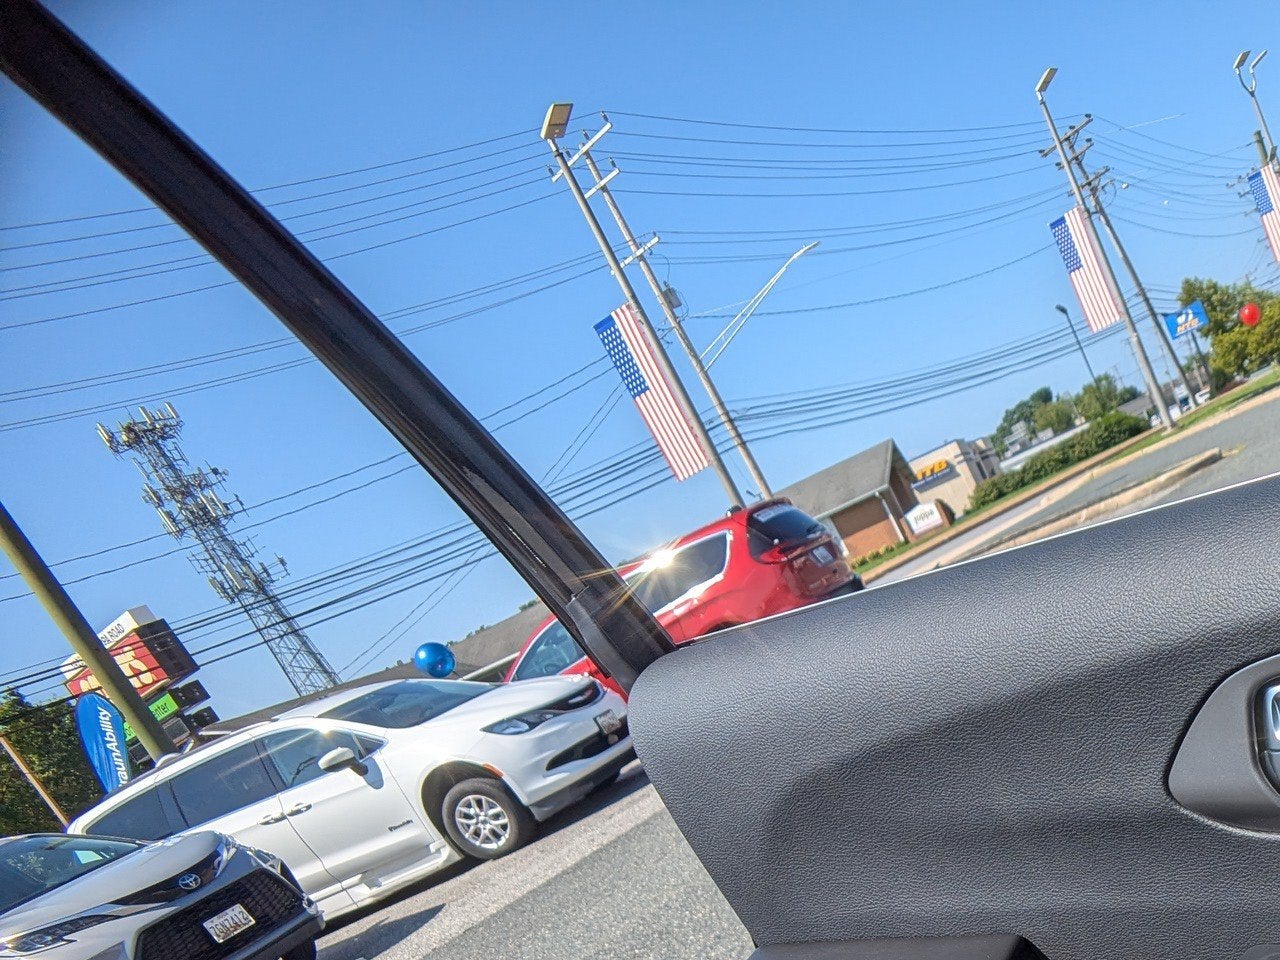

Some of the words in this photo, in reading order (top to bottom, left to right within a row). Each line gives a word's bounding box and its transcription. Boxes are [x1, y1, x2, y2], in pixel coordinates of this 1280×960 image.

[106, 623, 125, 641] ROAD
[152, 702, 170, 717] enter
[97, 705, 129, 787] raunAbility
